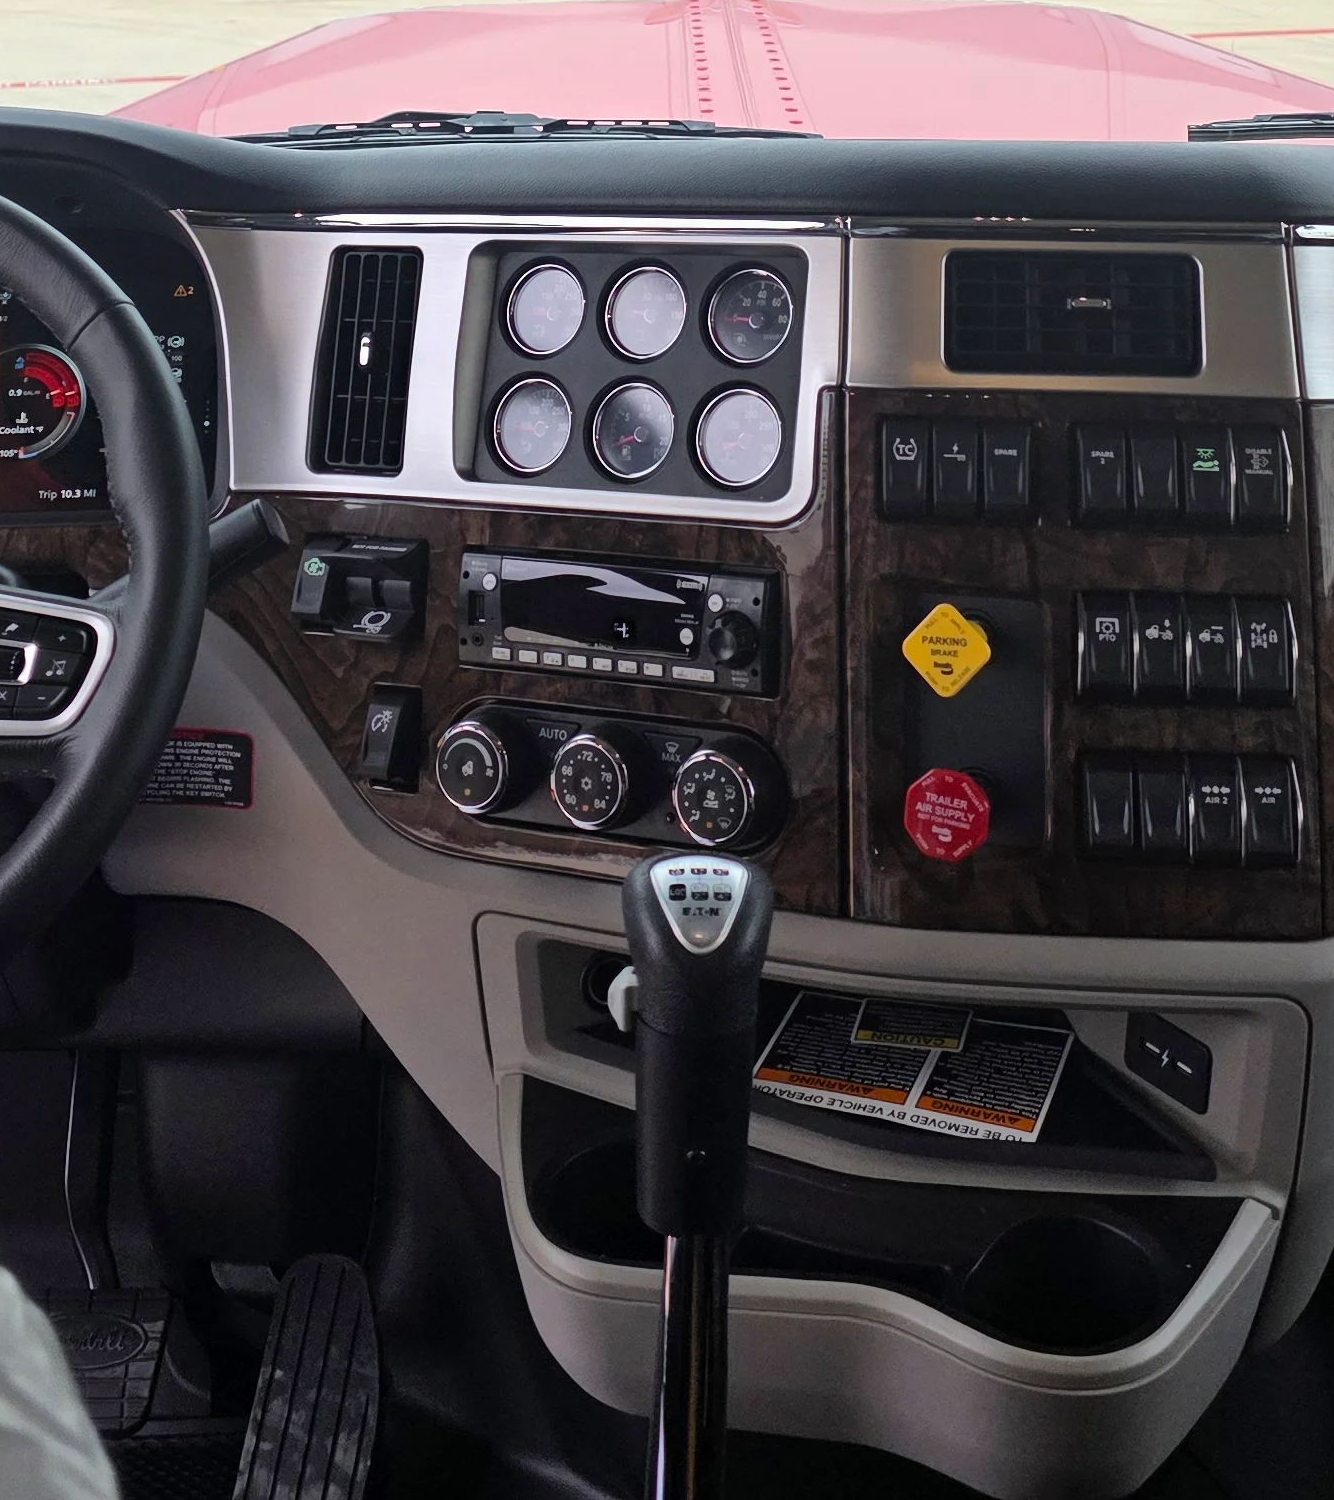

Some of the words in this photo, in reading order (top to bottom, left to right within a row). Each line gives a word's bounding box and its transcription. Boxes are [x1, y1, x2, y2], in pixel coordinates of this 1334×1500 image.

[187, 286, 195, 295] 2
[758, 290, 767, 298] 40
[742, 298, 752, 306] 20
[8, 389, 23, 397] 0.9
[897, 444, 914, 455] TC
[994, 448, 1018, 456] SPARE
[1091, 450, 1114, 458] SPARE
[38, 489, 58, 501] Trip
[60, 489, 81, 498] 10.3
[83, 489, 97, 498] MI
[921, 635, 967, 647] PARKING
[1098, 633, 1116, 642] PTO
[930, 649, 959, 658] BRAKE
[538, 727, 568, 741] AUTO
[581, 750, 593, 761] 72
[661, 752, 682, 763] MAX
[561, 765, 573, 777] 66
[600, 771, 613, 783] 78
[564, 794, 577, 805] 60
[594, 798, 606, 809] 84
[925, 791, 967, 810] TRAILER
[1205, 796, 1220, 804] AIR
[1222, 796, 1228, 805] 2
[1261, 796, 1276, 804] AIR
[915, 801, 933, 813] AIR
[935, 806, 975, 823] SUPPLY
[870, 1031, 946, 1047] CAUTION
[788, 1073, 864, 1094] WARNING
[826, 1097, 884, 1117] VEHICLE
[930, 1100, 1009, 1123] WARNING
[887, 1109, 907, 1122] BY
[909, 1114, 980, 1136] REMOVED
[981, 1128, 1001, 1140] BE
